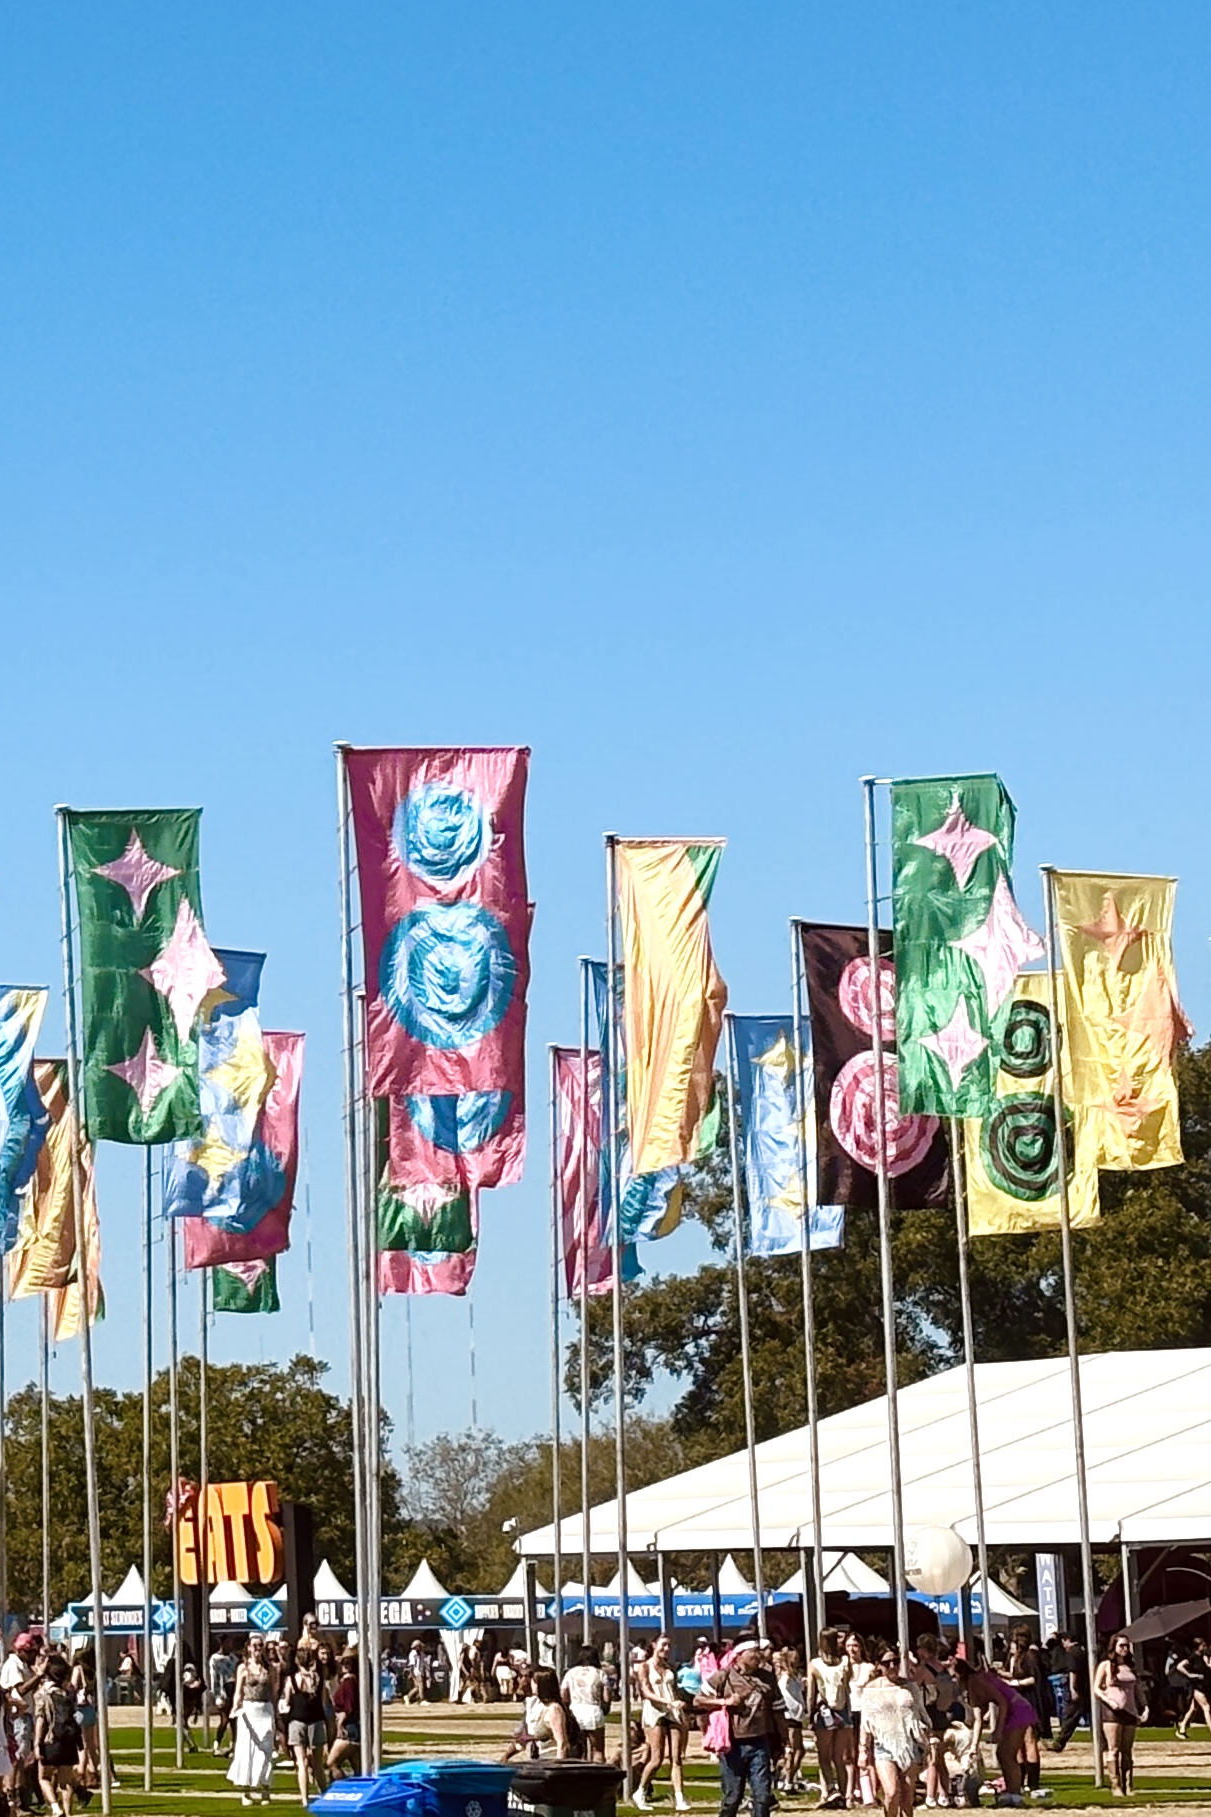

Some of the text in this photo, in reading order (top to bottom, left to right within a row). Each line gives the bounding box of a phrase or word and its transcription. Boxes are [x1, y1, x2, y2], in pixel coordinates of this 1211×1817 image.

[179, 1481, 276, 1585] EATS
[318, 1602, 413, 1625] CL BEGA
